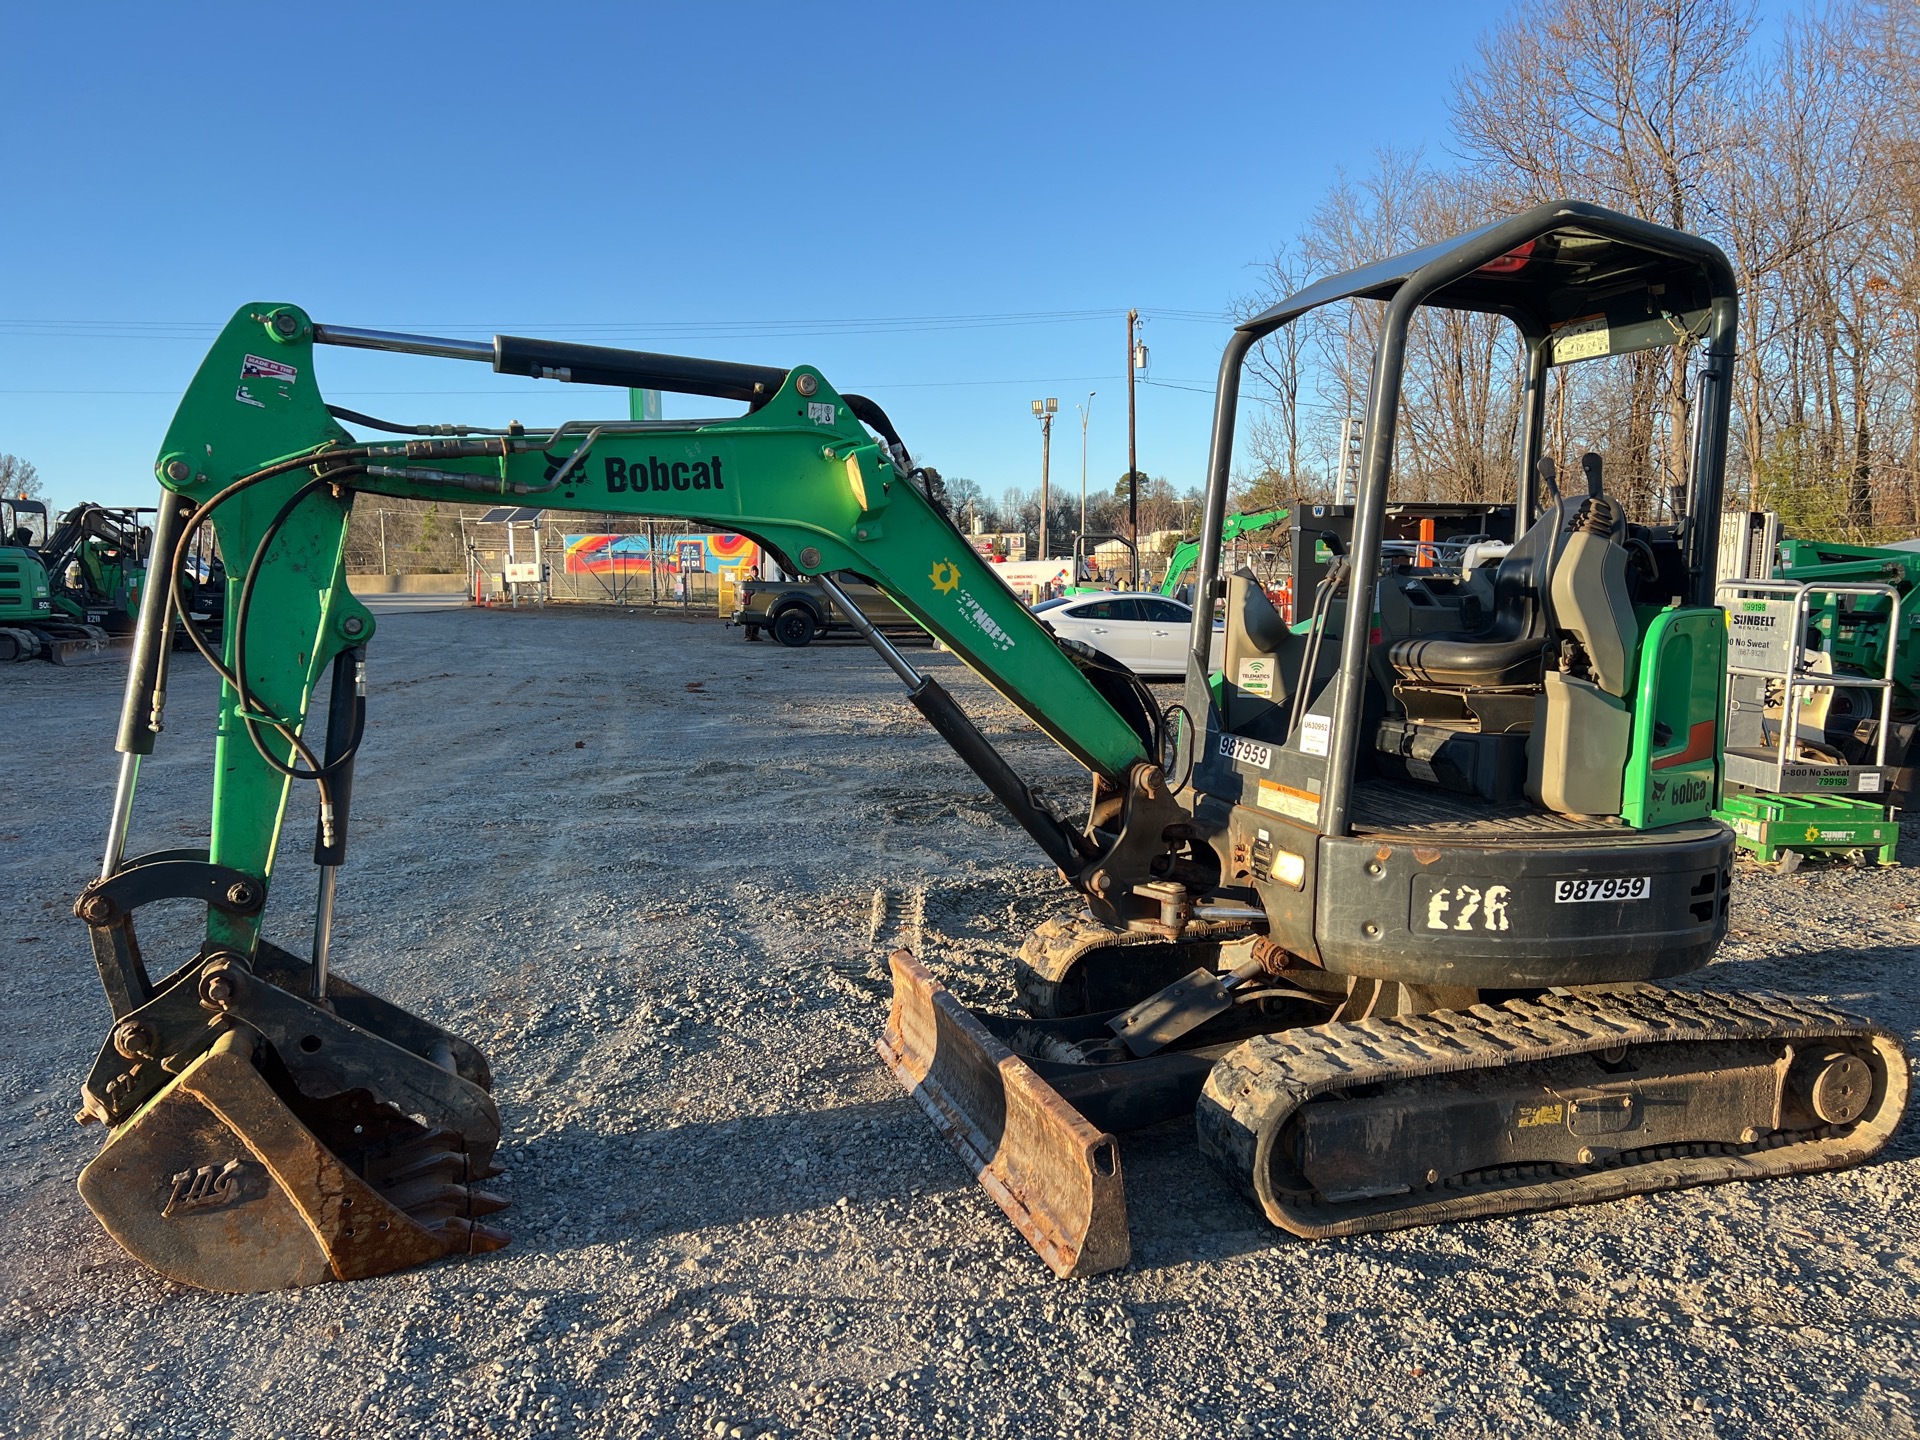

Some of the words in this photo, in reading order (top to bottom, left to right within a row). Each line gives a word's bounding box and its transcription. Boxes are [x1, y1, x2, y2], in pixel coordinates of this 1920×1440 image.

[247, 357, 269, 368] MADE
[280, 366, 293, 375] THE
[604, 456, 724, 493] Bobcat
[1733, 614, 1776, 627] SUNBELT
[1735, 637, 1746, 646] No
[1746, 639, 1770, 648] Sweat
[1220, 737, 1268, 765] 987959
[1818, 777, 1848, 786] 799198
[1558, 877, 1646, 901] 987959
